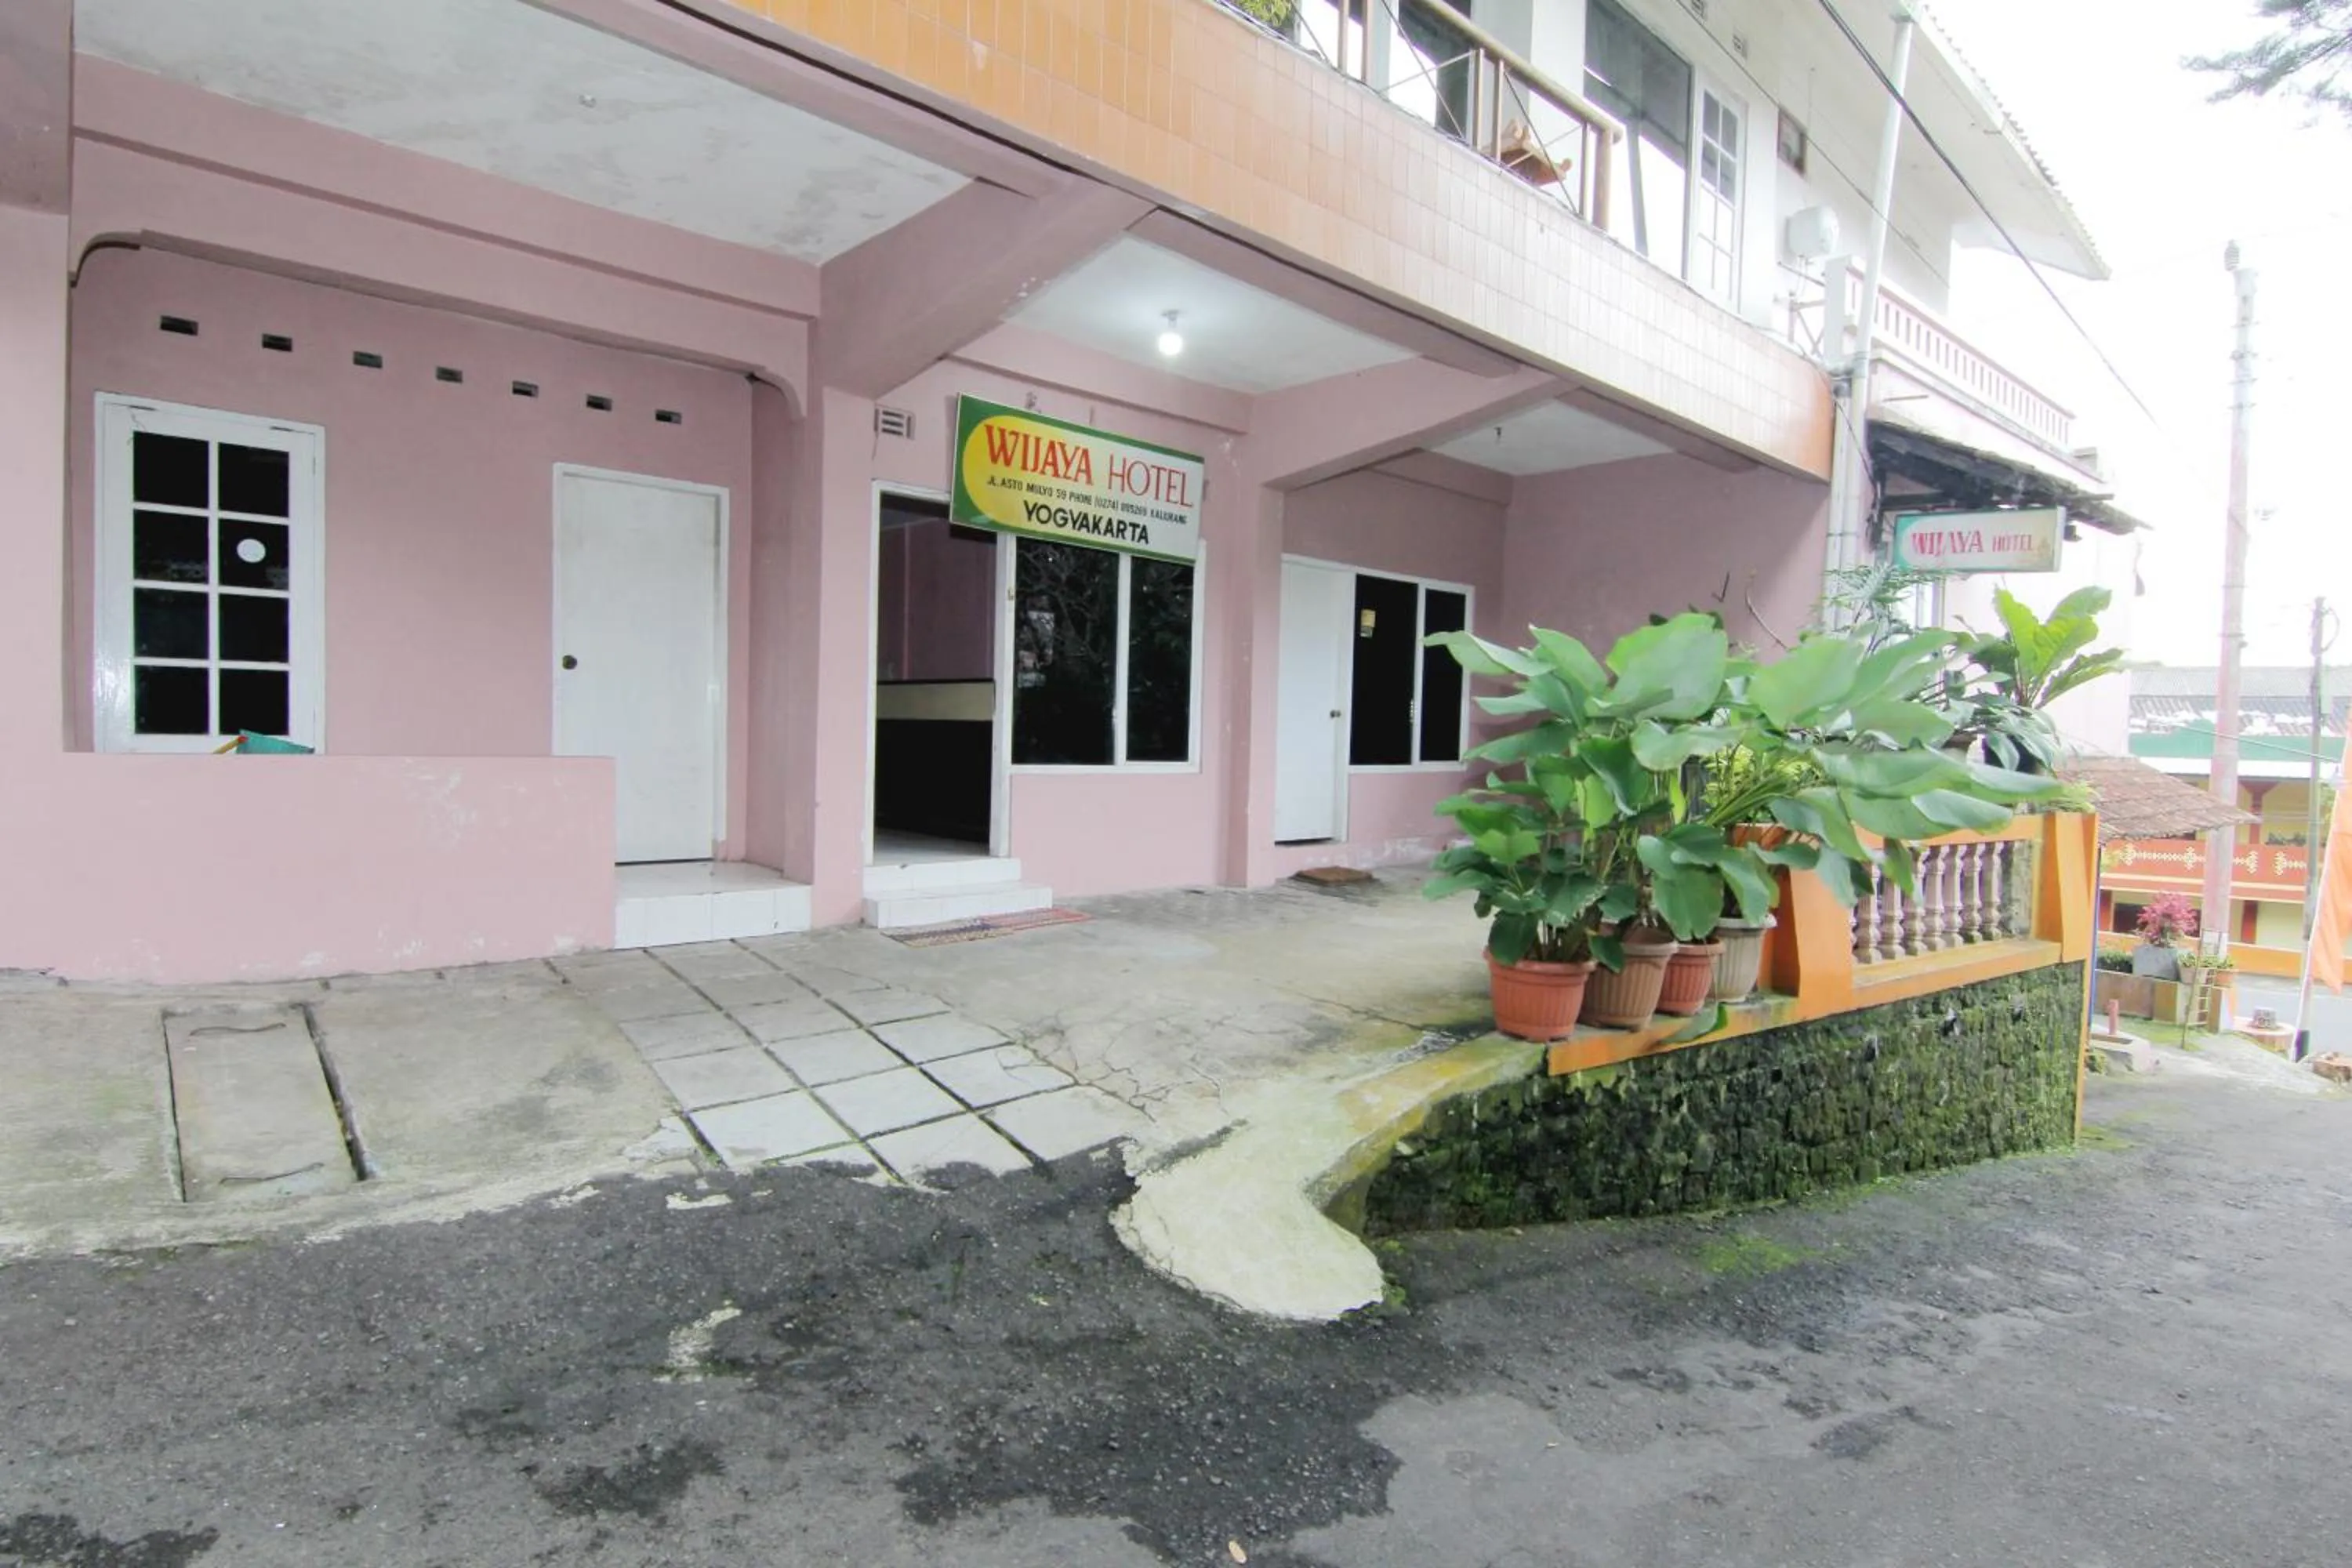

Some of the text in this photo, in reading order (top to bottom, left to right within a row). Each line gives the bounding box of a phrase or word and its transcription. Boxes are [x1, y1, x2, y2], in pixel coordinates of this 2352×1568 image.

[984, 424, 1194, 507] WIJAYA HOTEL
[1069, 492, 1092, 506] PHONE
[1023, 499, 1149, 545] YOGYAKARTA
[1911, 529, 2033, 557] WIJAYA HOTEL
